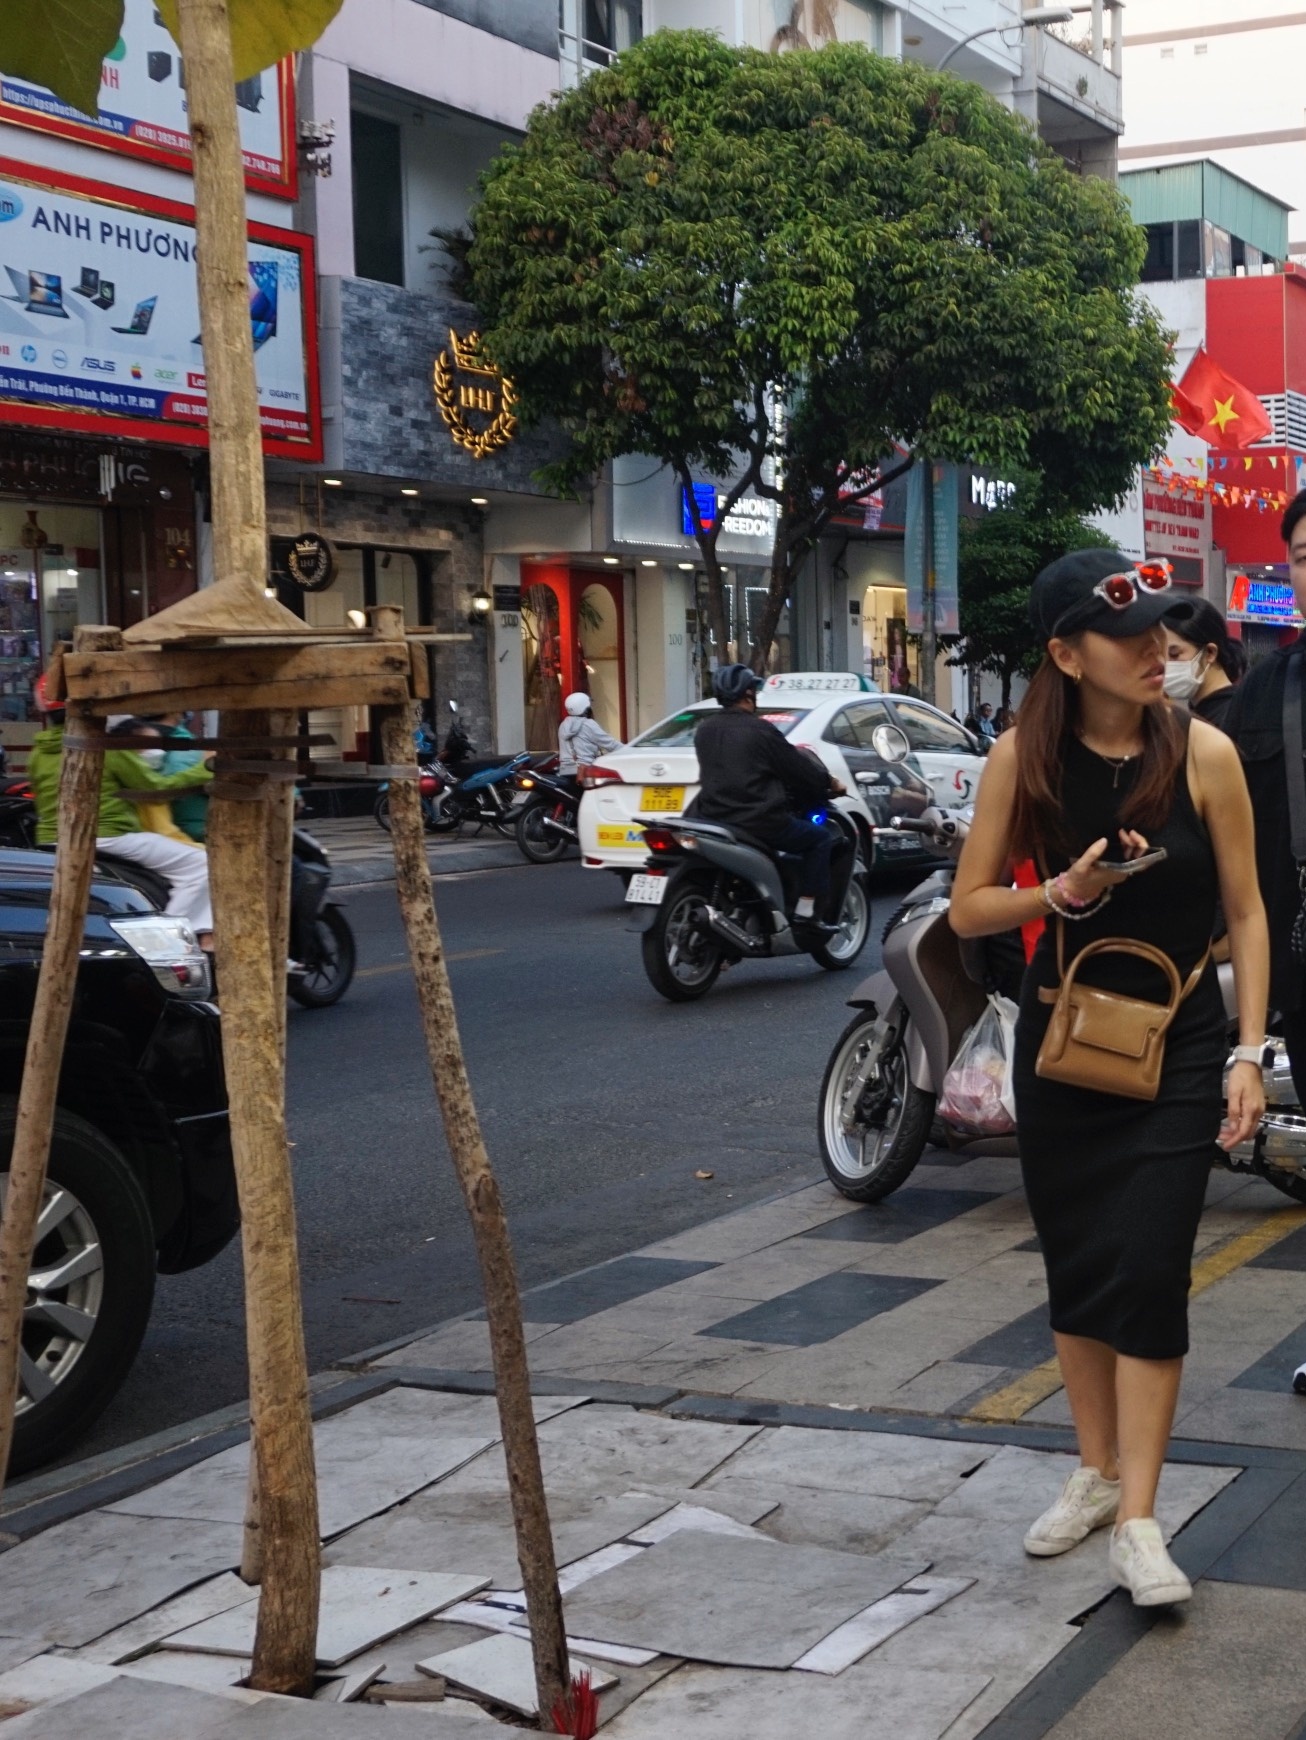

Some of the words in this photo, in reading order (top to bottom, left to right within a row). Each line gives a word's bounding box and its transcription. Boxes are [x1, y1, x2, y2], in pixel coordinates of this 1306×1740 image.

[32, 206, 91, 241] ANH
[81, 357, 117, 372] ASUS
[154, 368, 178, 380] acer
[269, 388, 300, 401] GIGABYTE
[164, 527, 191, 547] 104
[722, 515, 772, 537] REEDOM
[668, 633, 683, 646] 100
